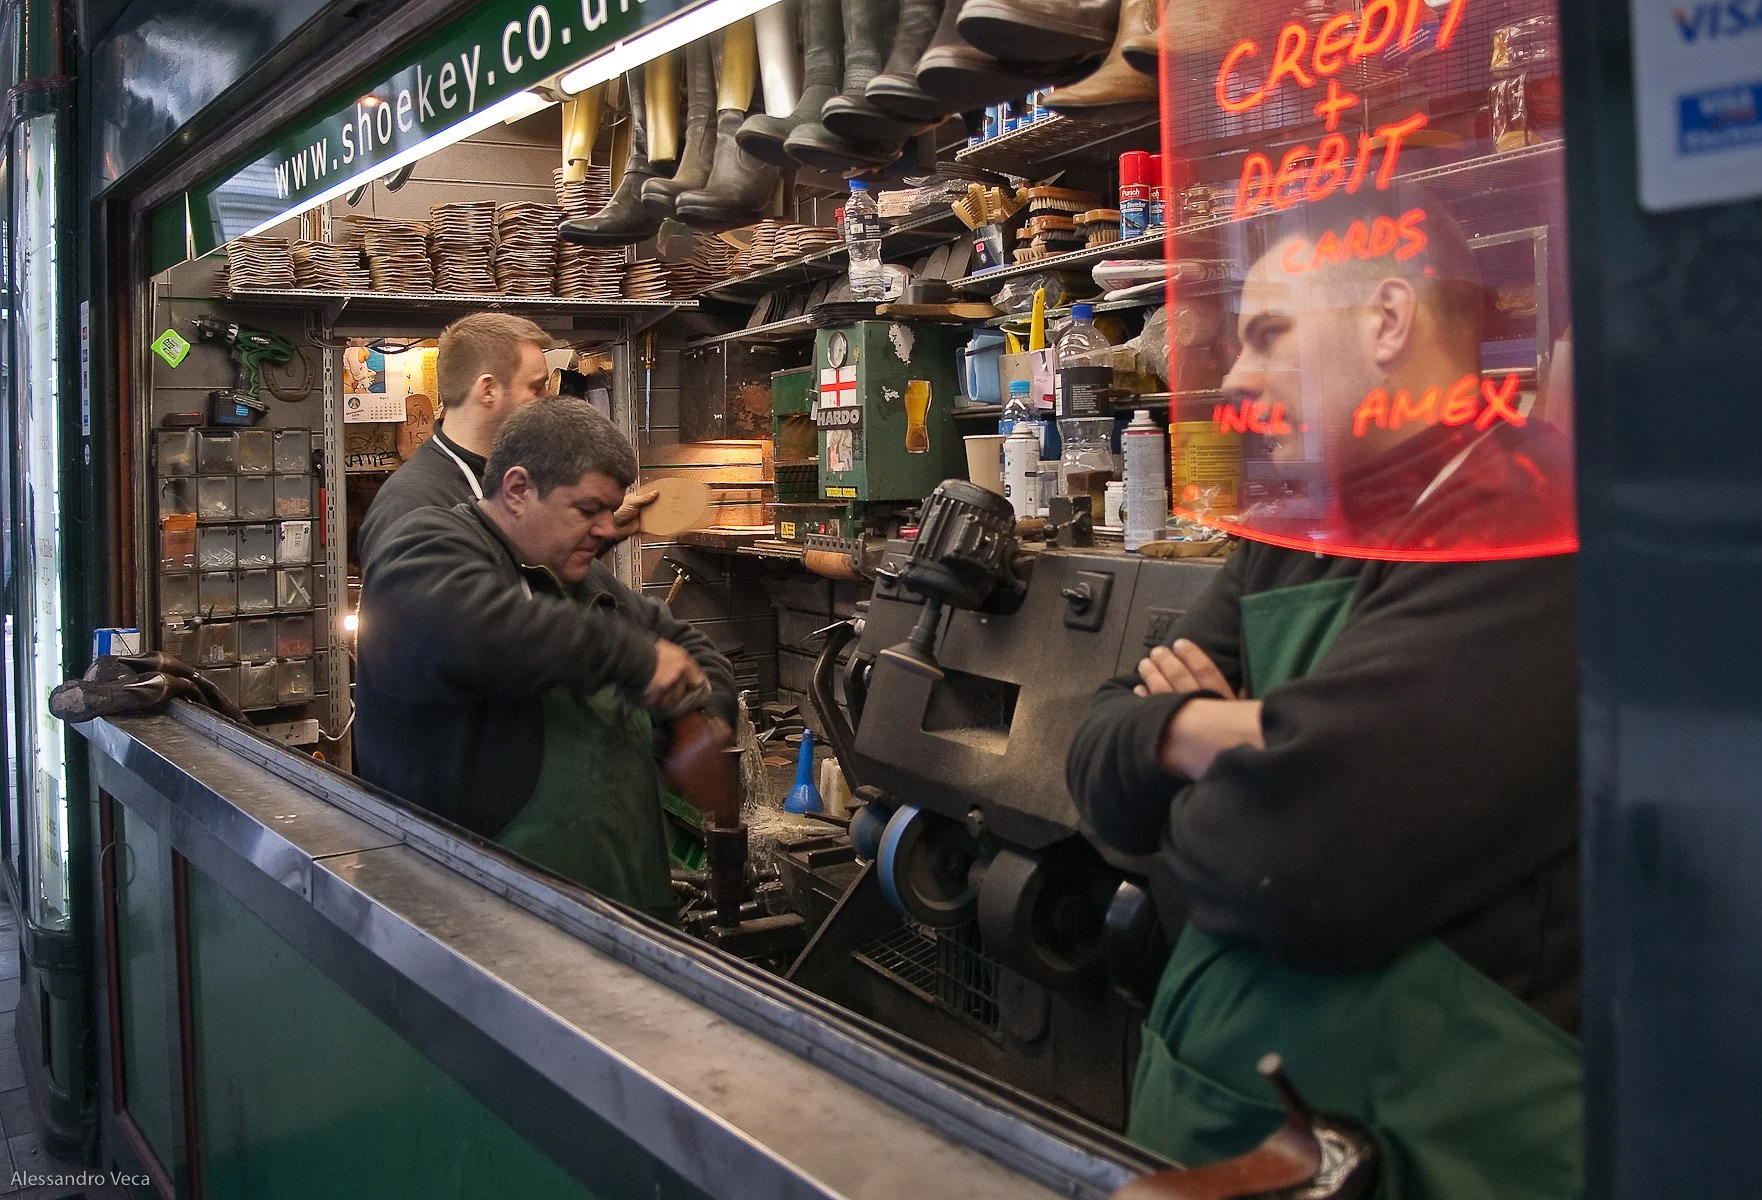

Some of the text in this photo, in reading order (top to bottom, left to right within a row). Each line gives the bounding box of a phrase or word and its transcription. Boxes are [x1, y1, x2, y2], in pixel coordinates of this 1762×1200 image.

[273, 0, 648, 200] www.shoekey.co.u
[1121, 188, 1140, 198] Punch
[1232, 112, 1429, 221] DEBIT
[817, 409, 860, 426] HARDO
[1352, 373, 1527, 439] AMEX
